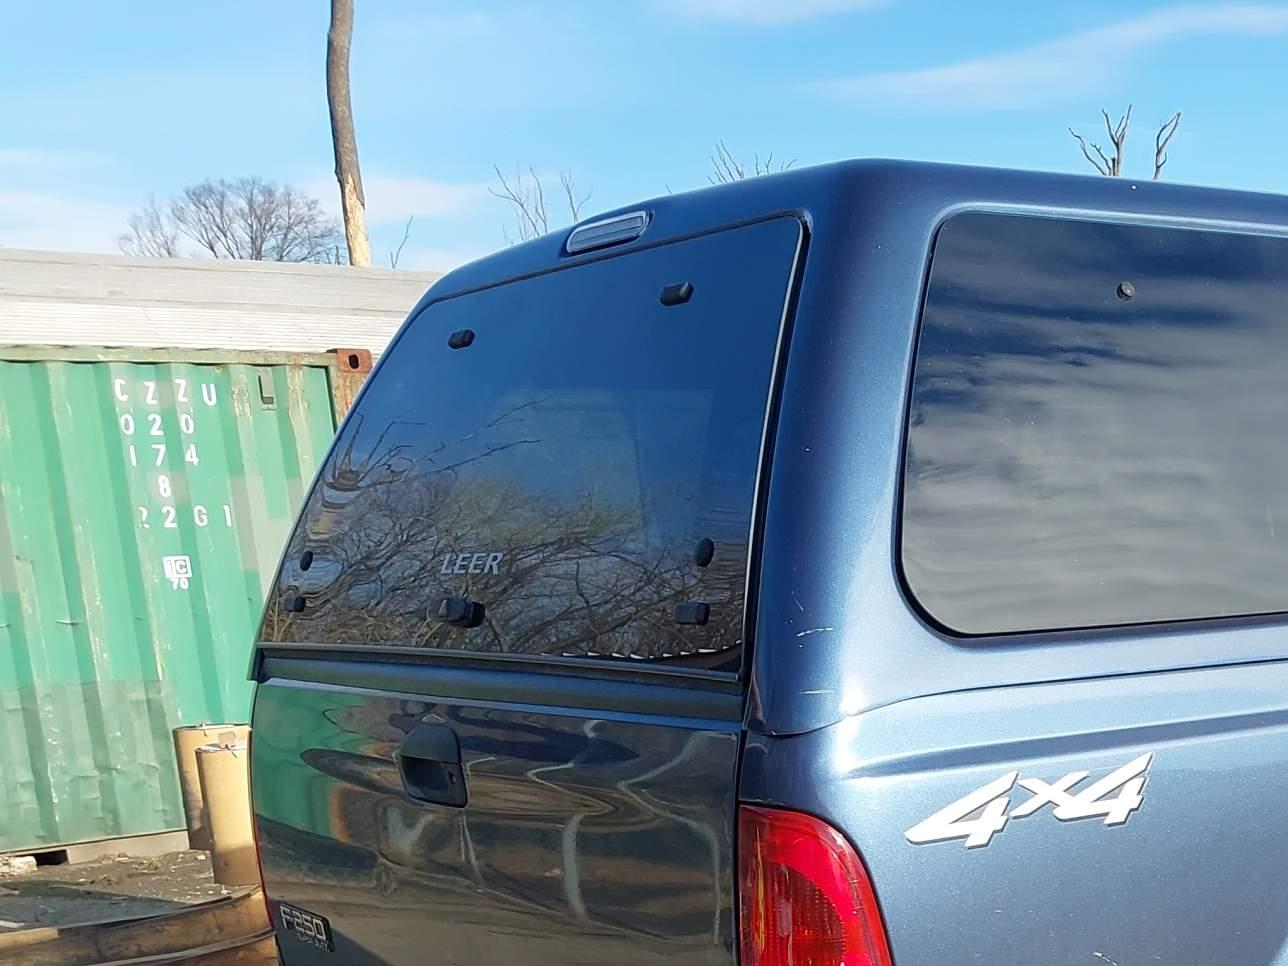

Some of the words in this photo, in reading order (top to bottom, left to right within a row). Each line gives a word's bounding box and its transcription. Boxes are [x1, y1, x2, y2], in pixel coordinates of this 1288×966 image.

[120, 413, 195, 435] 020
[129, 443, 199, 467] 174
[158, 475, 172, 498] 8
[440, 552, 504, 576] LEER
